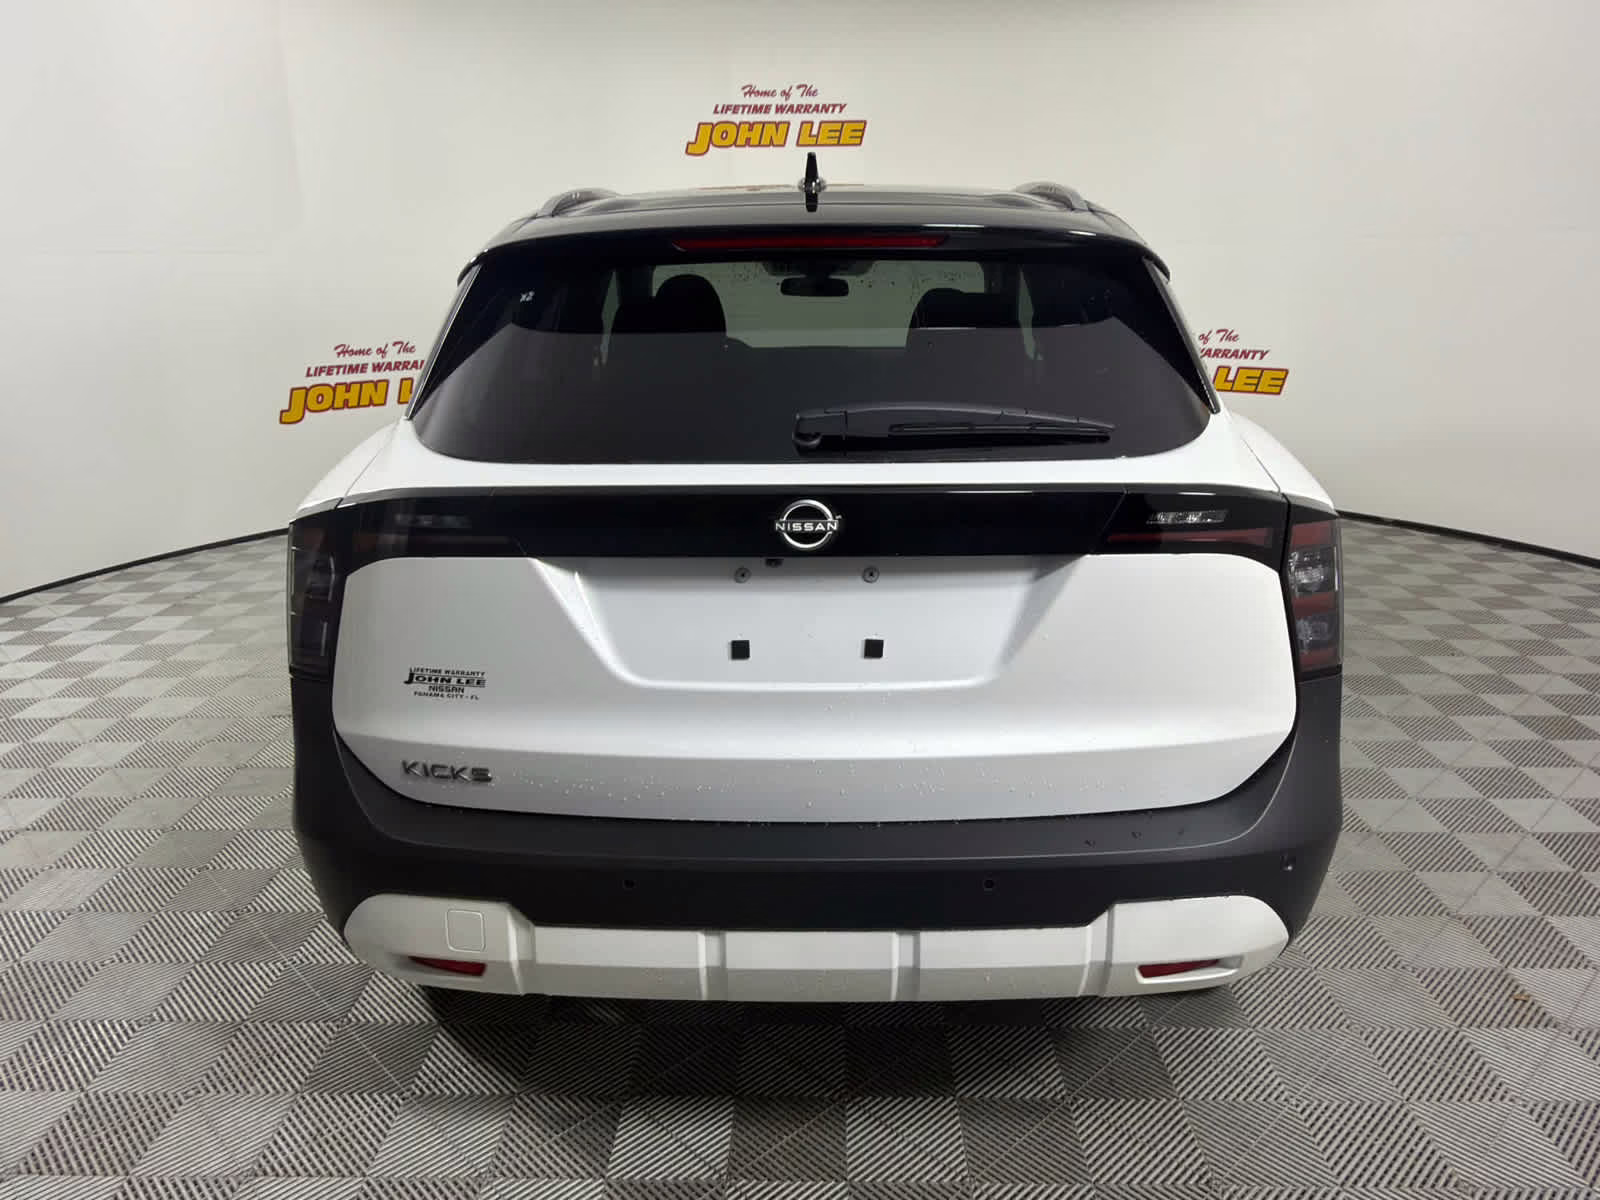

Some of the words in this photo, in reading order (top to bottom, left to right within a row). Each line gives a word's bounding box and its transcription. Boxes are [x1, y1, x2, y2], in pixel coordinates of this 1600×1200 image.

[741, 84, 777, 98] Home
[780, 85, 793, 101] of
[796, 84, 819, 97] The
[713, 104, 771, 114] LIFETIME
[775, 103, 847, 114] WARRANTY
[684, 120, 790, 156] JOHN
[796, 120, 867, 147] LEE
[1198, 330, 1212, 345] of
[1216, 329, 1240, 342] The
[334, 344, 373, 358] Home
[376, 343, 389, 358] of
[392, 341, 416, 354] The
[1200, 347, 1269, 360] ARRANTY
[305, 363, 368, 378] LIFETIME
[371, 360, 425, 373] WARRA
[1213, 365, 1289, 395] LEE
[279, 379, 390, 424] JOHN
[775, 522, 838, 532] NISSAN
[403, 672, 452, 685] JOHN
[456, 678, 487, 688] LEE
[444, 669, 486, 677] WARRANTY
[428, 685, 465, 694] NISSAN
[401, 760, 493, 783] KICKS
